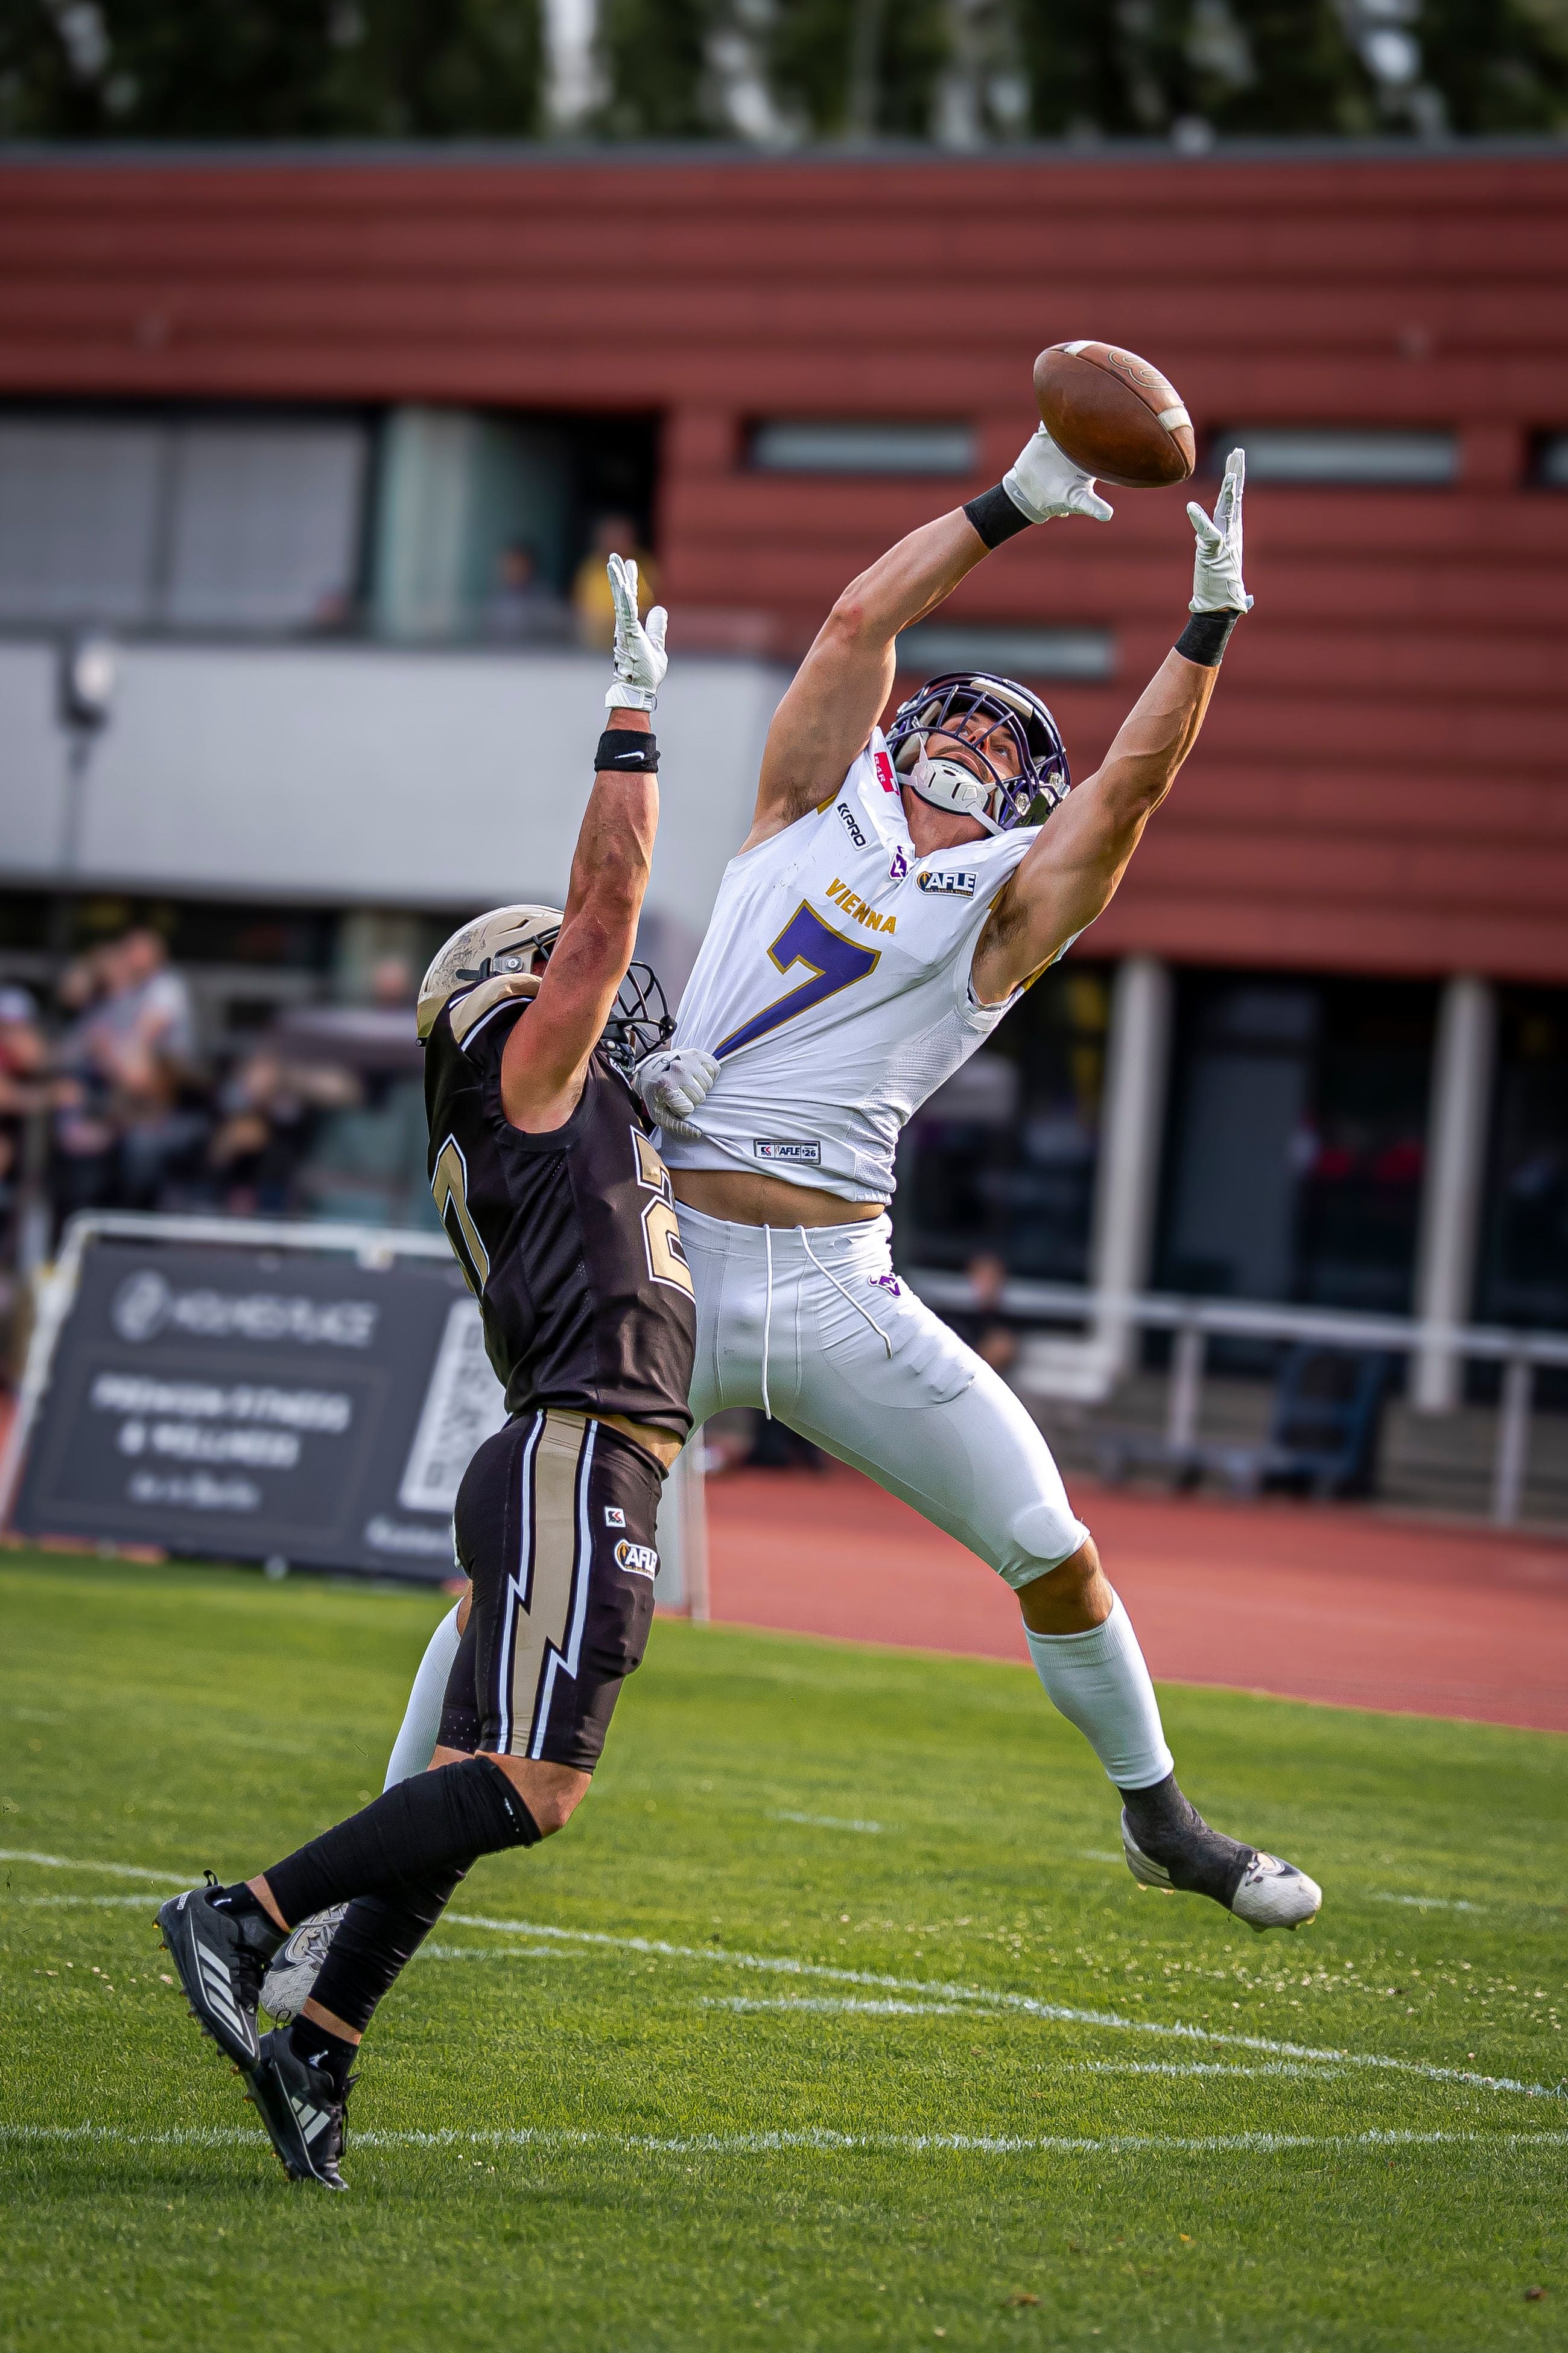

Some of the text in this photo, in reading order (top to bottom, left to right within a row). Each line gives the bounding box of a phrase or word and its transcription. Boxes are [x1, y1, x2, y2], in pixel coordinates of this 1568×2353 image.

[925, 873, 976, 892] AFLE
[825, 877, 897, 934] VIENNA
[711, 898, 882, 1062] 7
[778, 1147, 801, 1156] AFLE
